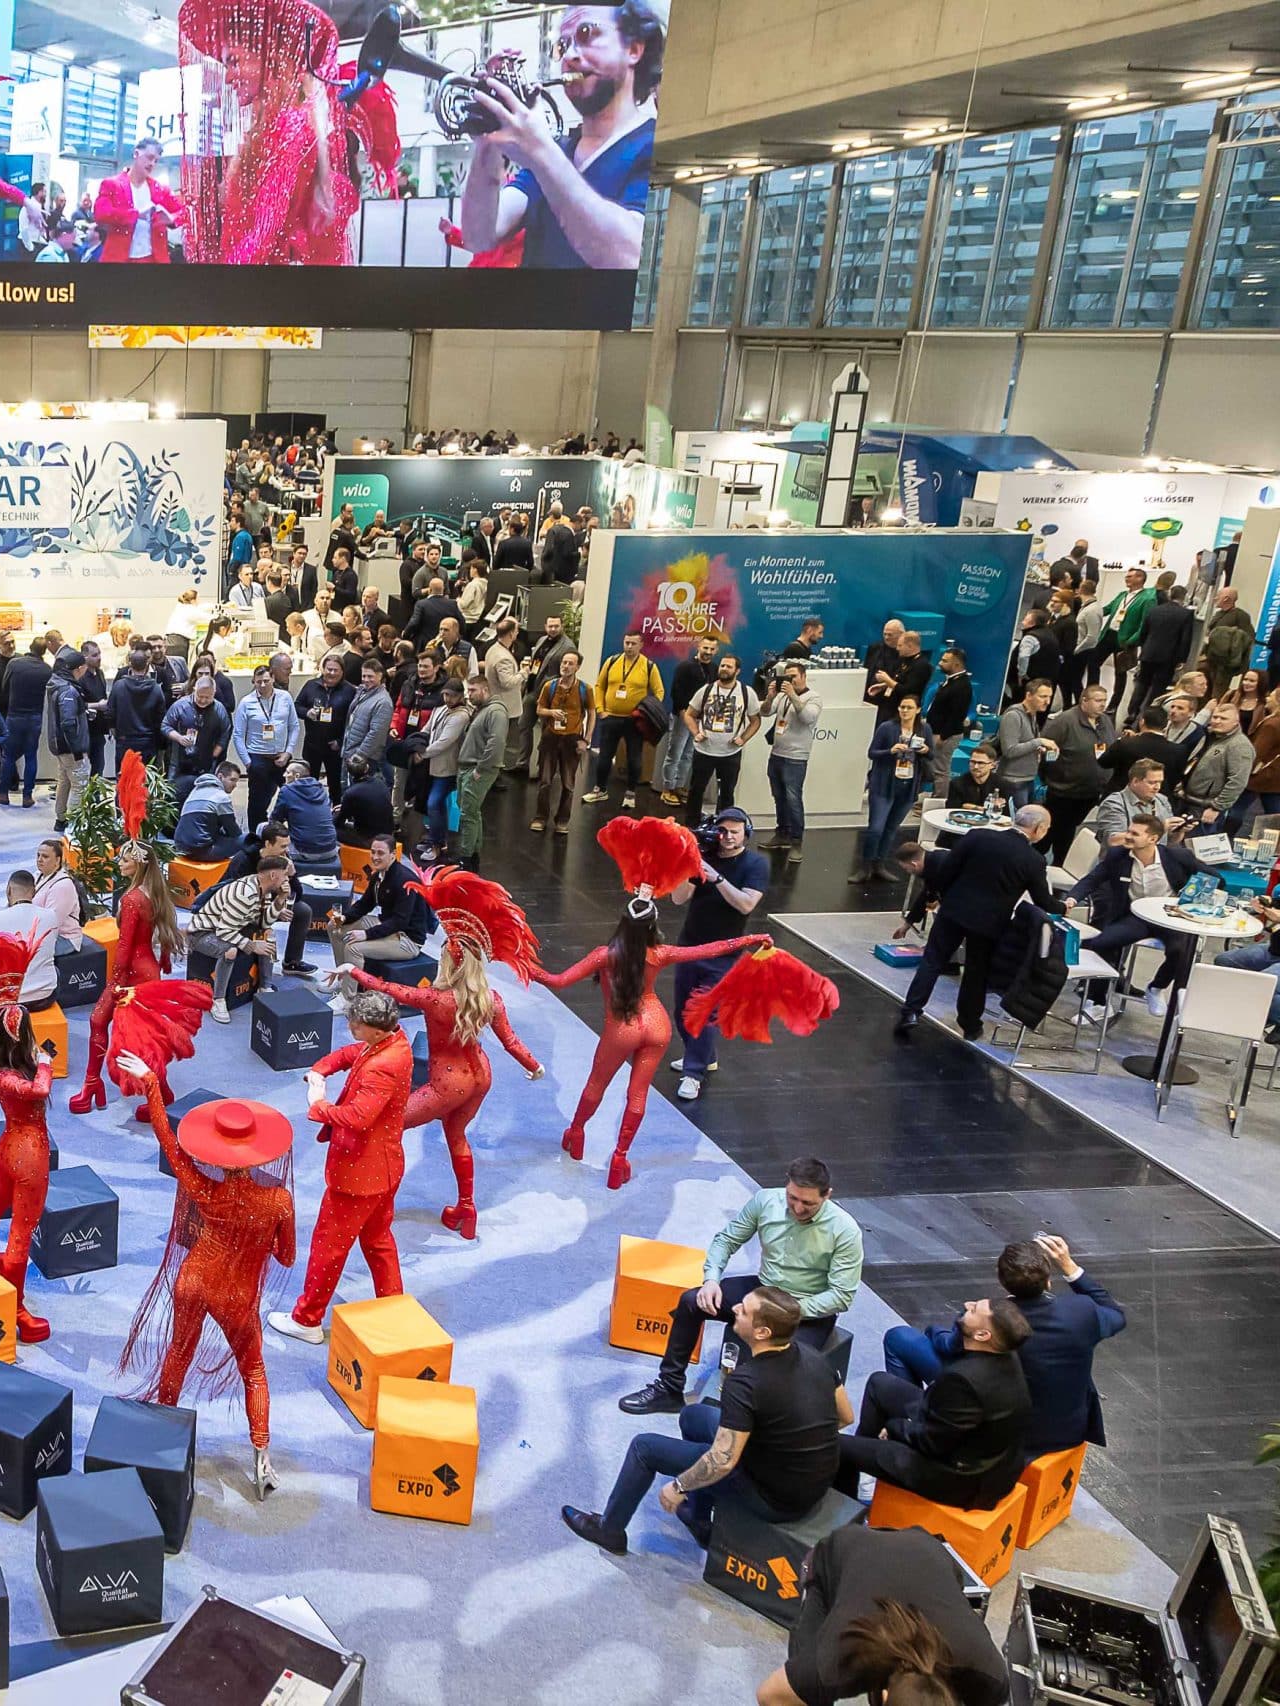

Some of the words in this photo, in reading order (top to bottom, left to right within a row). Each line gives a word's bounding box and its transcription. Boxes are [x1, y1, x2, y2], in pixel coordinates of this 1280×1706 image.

[46, 283, 74, 302] us!
[342, 483, 371, 497] wilo
[1022, 496, 1056, 504] WERNER
[1143, 495, 1194, 503] SCHLÖSSER
[675, 504, 693, 519] wilo
[744, 559, 757, 567] Ein
[759, 556, 806, 567] Moment
[750, 569, 837, 585] Wohlfühlen.
[657, 581, 697, 612] 10
[68, 970, 98, 984] ALVA
[287, 1030, 320, 1044] ALVA
[60, 1226, 102, 1246] ALVA
[636, 1318, 668, 1335] EXPO
[335, 1359, 352, 1385] EXPO
[35, 1431, 65, 1469] ALVA
[398, 1480, 433, 1497] EXPO
[79, 1569, 139, 1593] ALVA
[725, 1555, 767, 1591] EXPO
